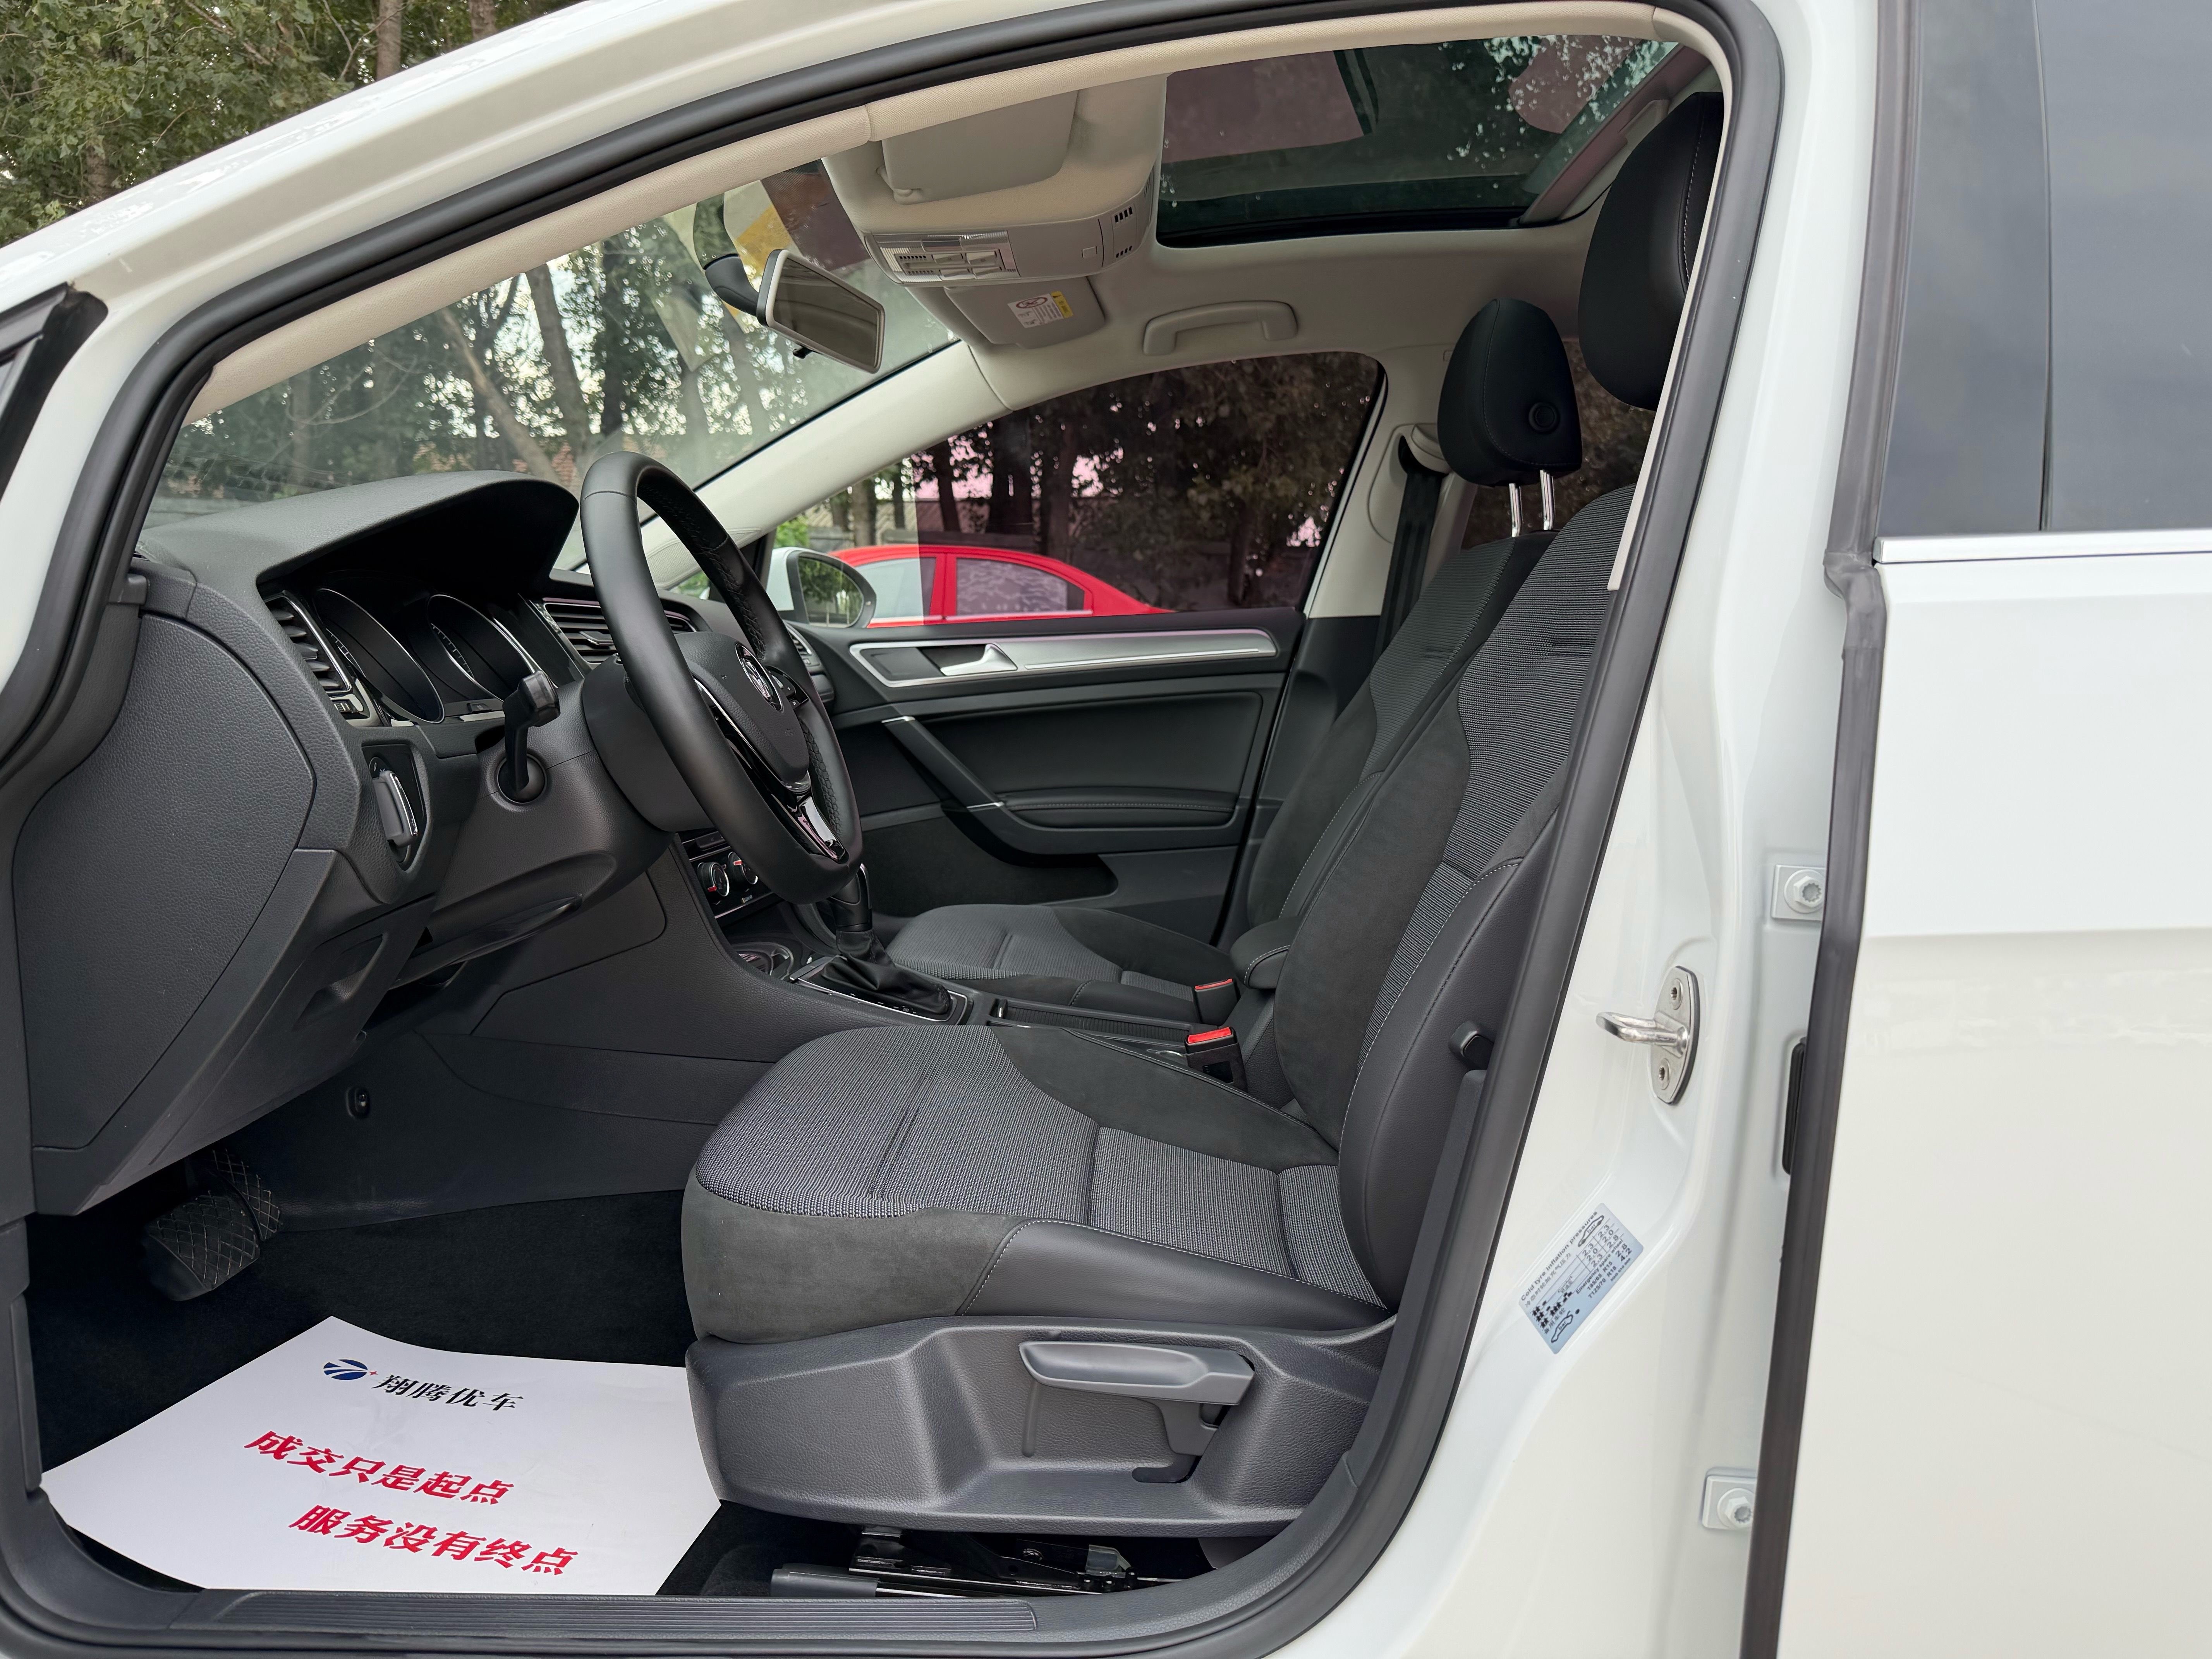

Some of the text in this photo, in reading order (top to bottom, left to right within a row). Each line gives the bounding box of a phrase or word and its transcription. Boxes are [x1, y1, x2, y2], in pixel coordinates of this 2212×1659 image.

[1582, 1224, 1611, 1257] 2.3 2.3
[1586, 1221, 1596, 1234] bar
[1586, 1229, 1615, 1262] 2.0 2.0
[1521, 1284, 1535, 1301] Cold
[1534, 1271, 1546, 1285] tyre
[1569, 1211, 1597, 1245] pressures
[1575, 1237, 1624, 1295] Emergency spare wheel
[1587, 1273, 1602, 1290] 195/65
[1602, 1261, 1613, 1273] R15
[1615, 1243, 1628, 1258] 2.8
[1590, 1234, 1620, 1268] 2.3 2.8
[1588, 1278, 1606, 1298] T125/70
[1606, 1265, 1617, 1278] R18
[1620, 1247, 1632, 1262] 4.2
[1558, 1320, 1566, 1331] bar
[371, 1374, 524, 1411] 翔腾优车
[244, 1431, 514, 1505] 成交只是起点
[289, 1504, 579, 1576] 服务没有终点
